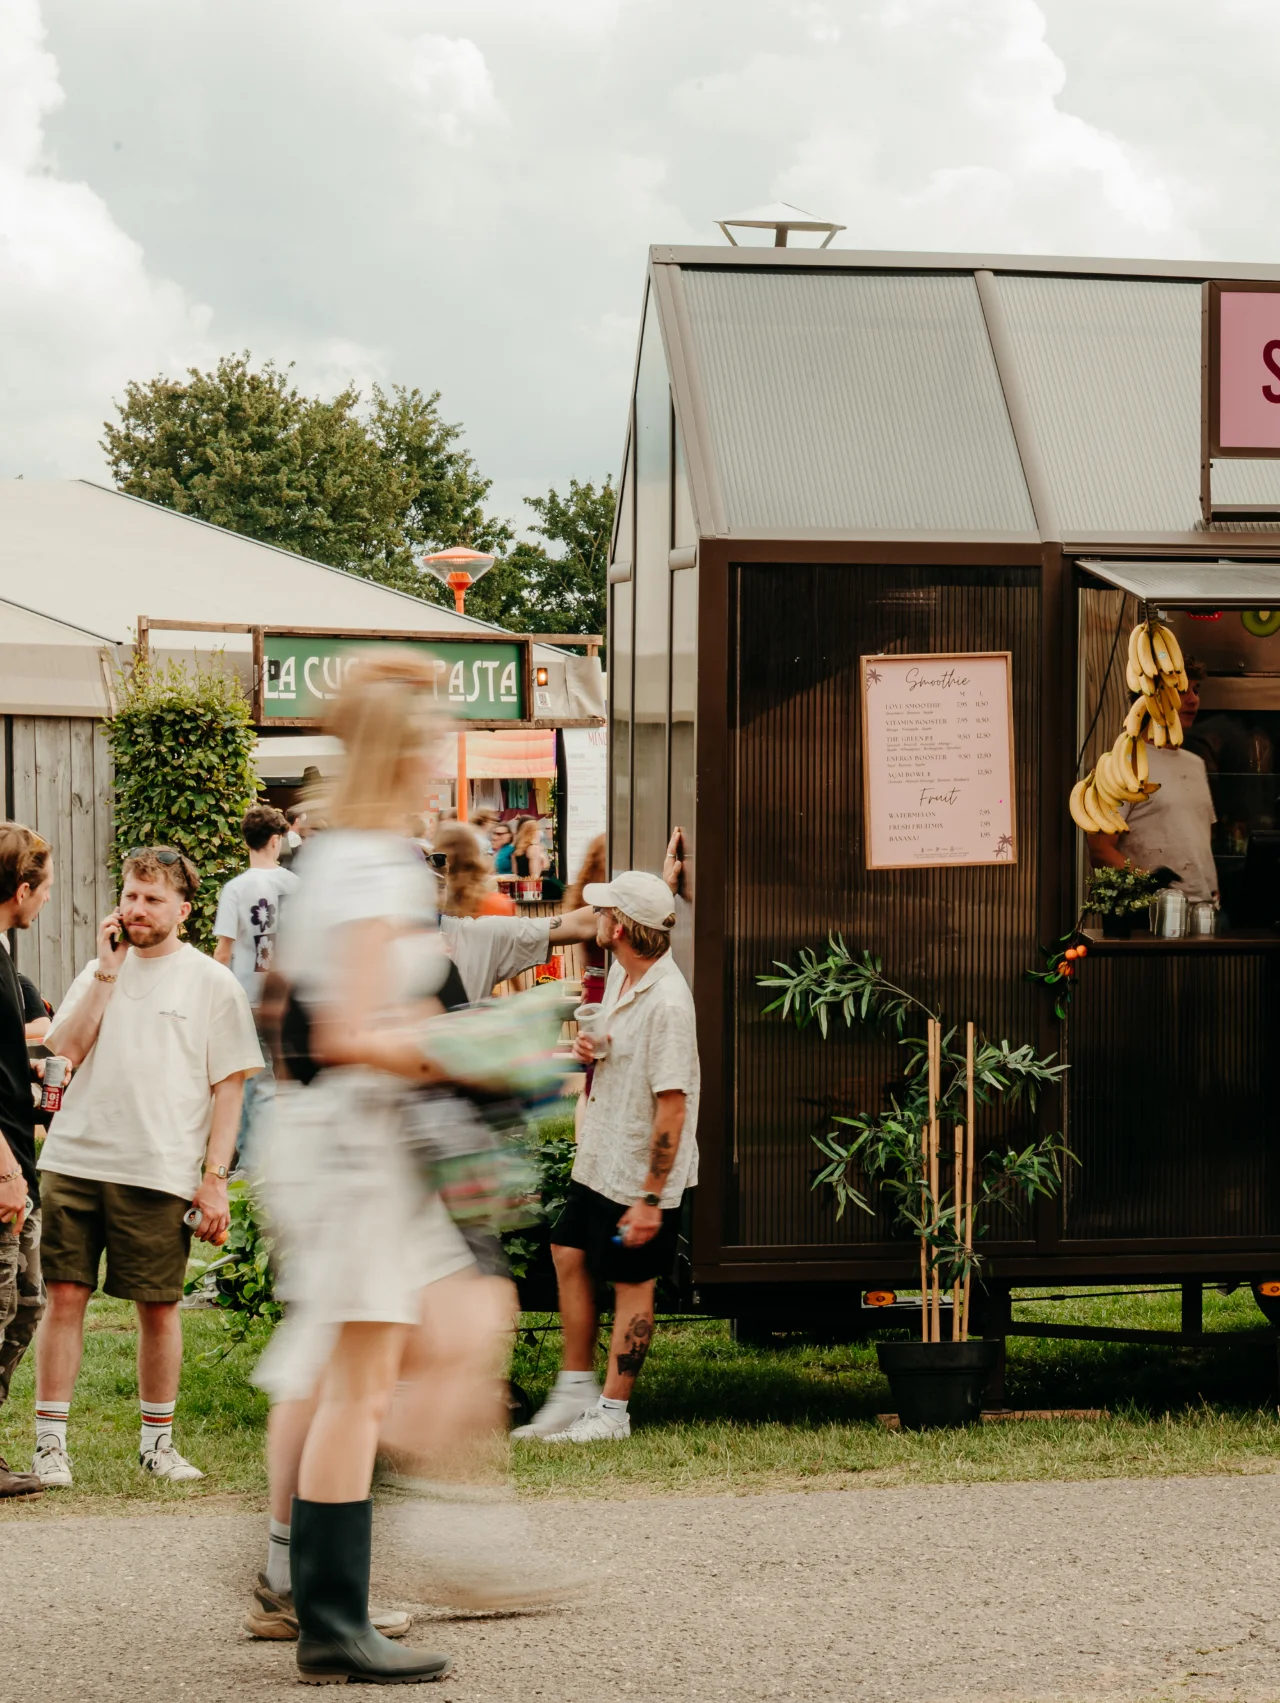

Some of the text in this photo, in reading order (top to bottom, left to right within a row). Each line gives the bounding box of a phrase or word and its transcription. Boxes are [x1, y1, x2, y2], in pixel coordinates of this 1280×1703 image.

[263, 655, 297, 700] LA
[431, 659, 518, 702] PASTA
[905, 667, 971, 691] Smoothie
[914, 753, 947, 761] BOOSTER
[919, 787, 962, 807] Fruit
